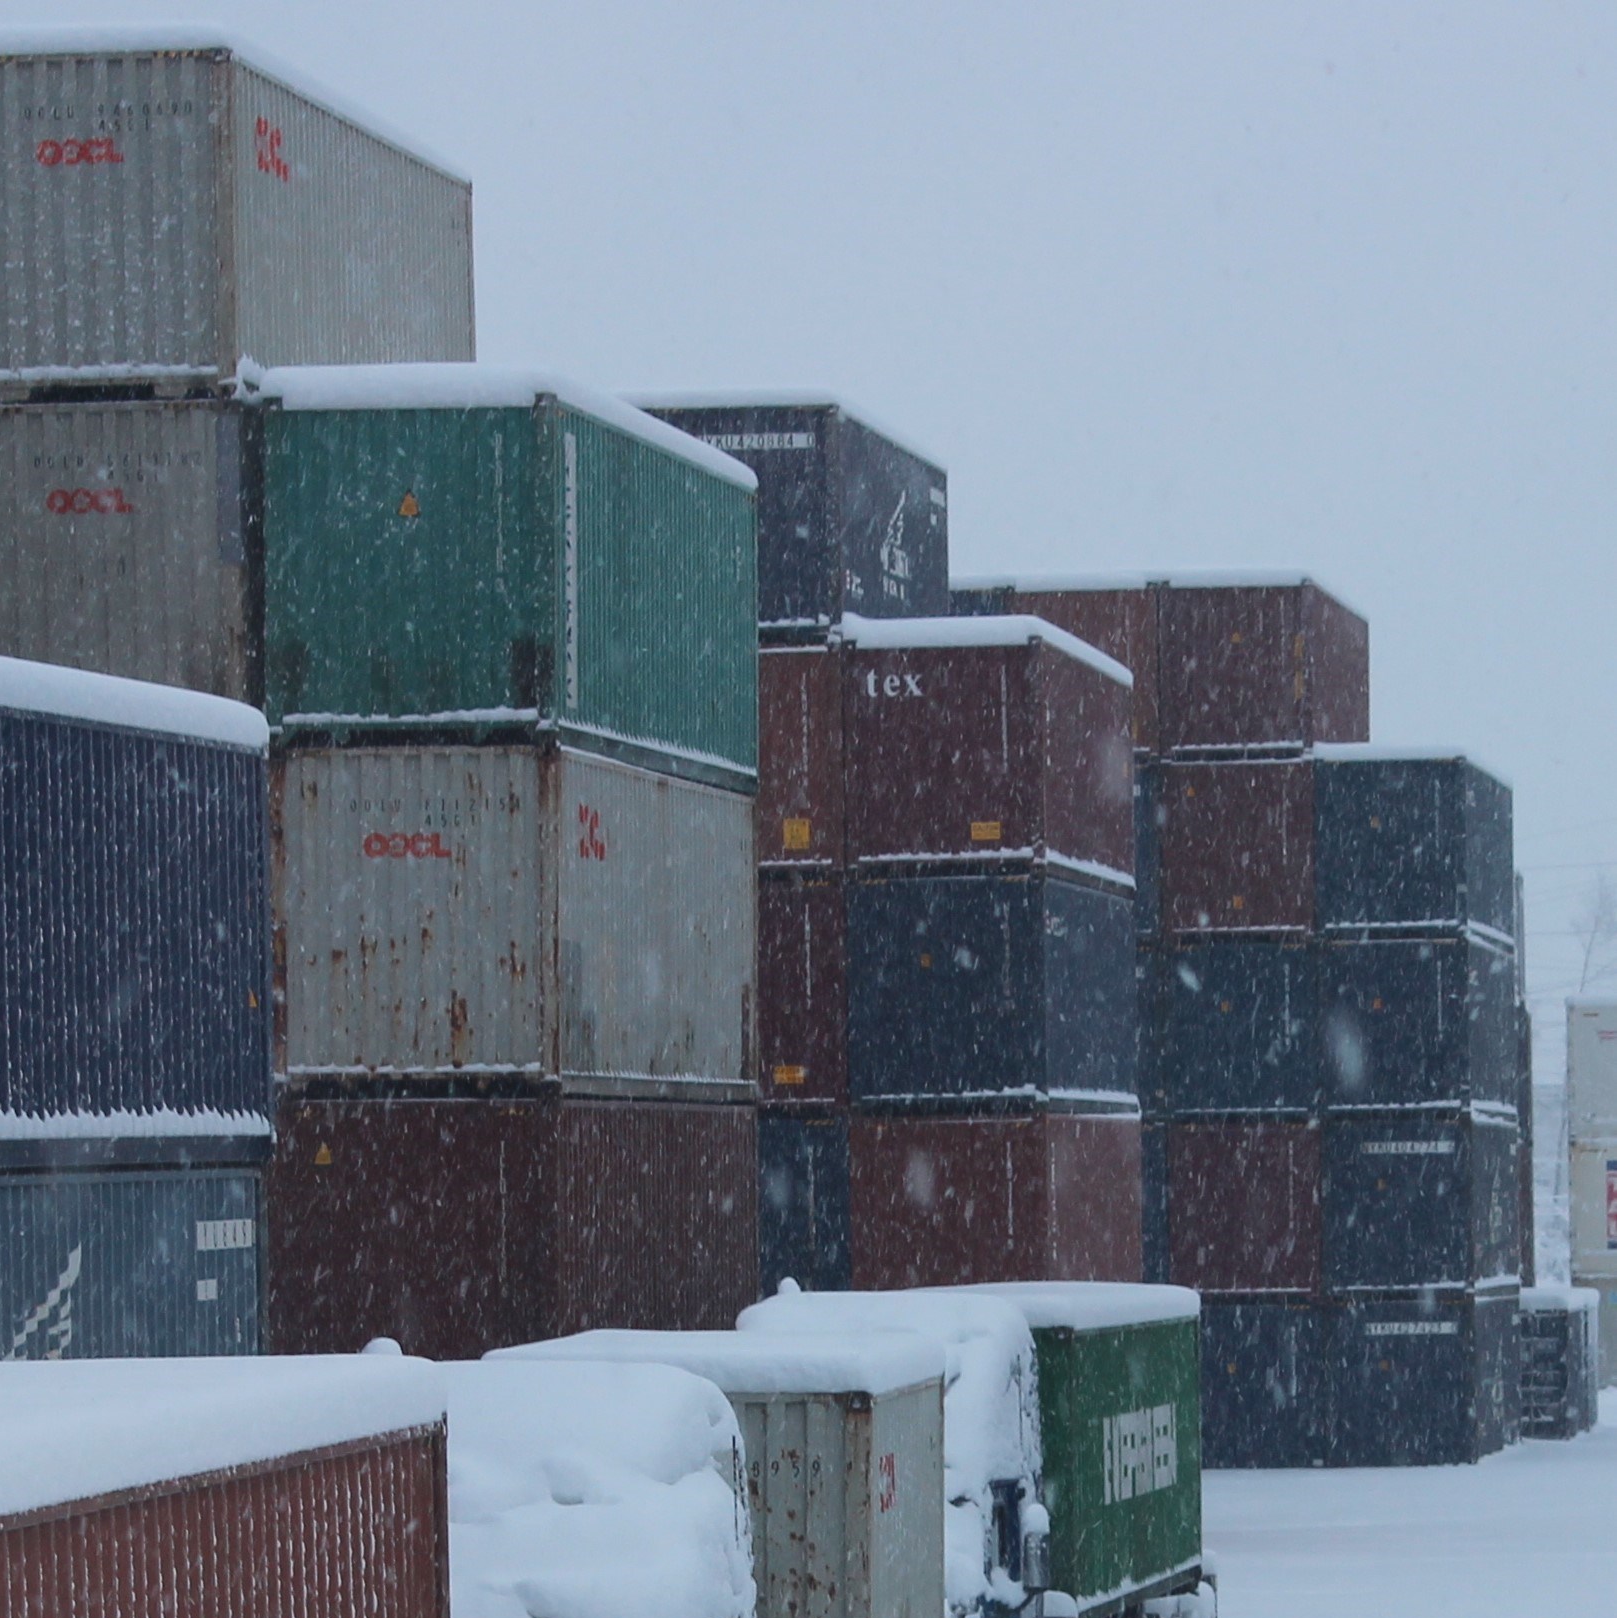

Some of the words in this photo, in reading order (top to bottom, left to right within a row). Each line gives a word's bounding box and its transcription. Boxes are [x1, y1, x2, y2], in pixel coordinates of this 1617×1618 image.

[36, 137, 125, 167] OOCL
[866, 668, 925, 698] tex
[363, 832, 452, 859] OOCL
